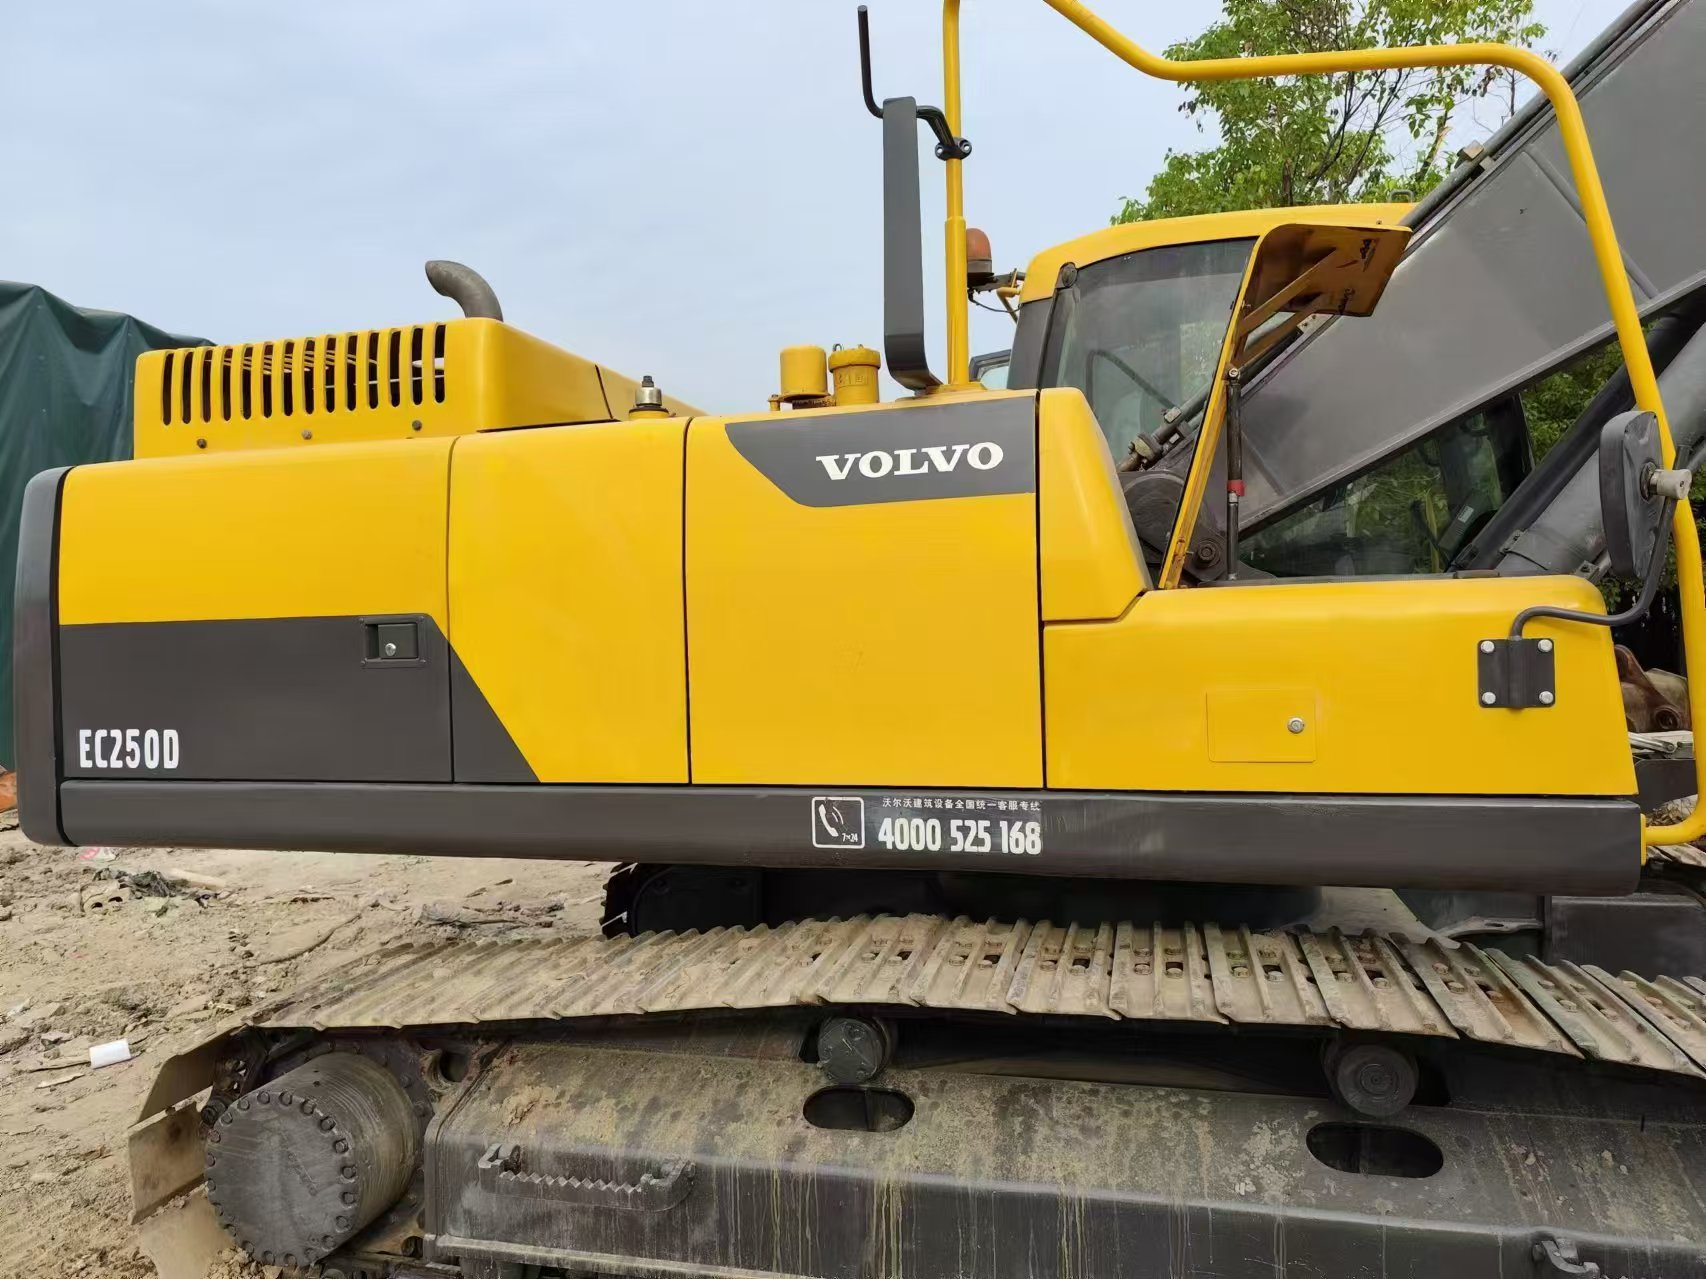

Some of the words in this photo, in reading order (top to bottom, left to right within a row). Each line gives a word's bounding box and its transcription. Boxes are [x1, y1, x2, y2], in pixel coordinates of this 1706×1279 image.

[815, 441, 1004, 481] VOLVO
[79, 728, 180, 770] EC250D
[882, 797, 1042, 811] 沃尔沃建筑设备全国统一客服专线
[878, 817, 942, 851] 4000
[950, 819, 992, 853] 525
[999, 820, 1042, 855] 168
